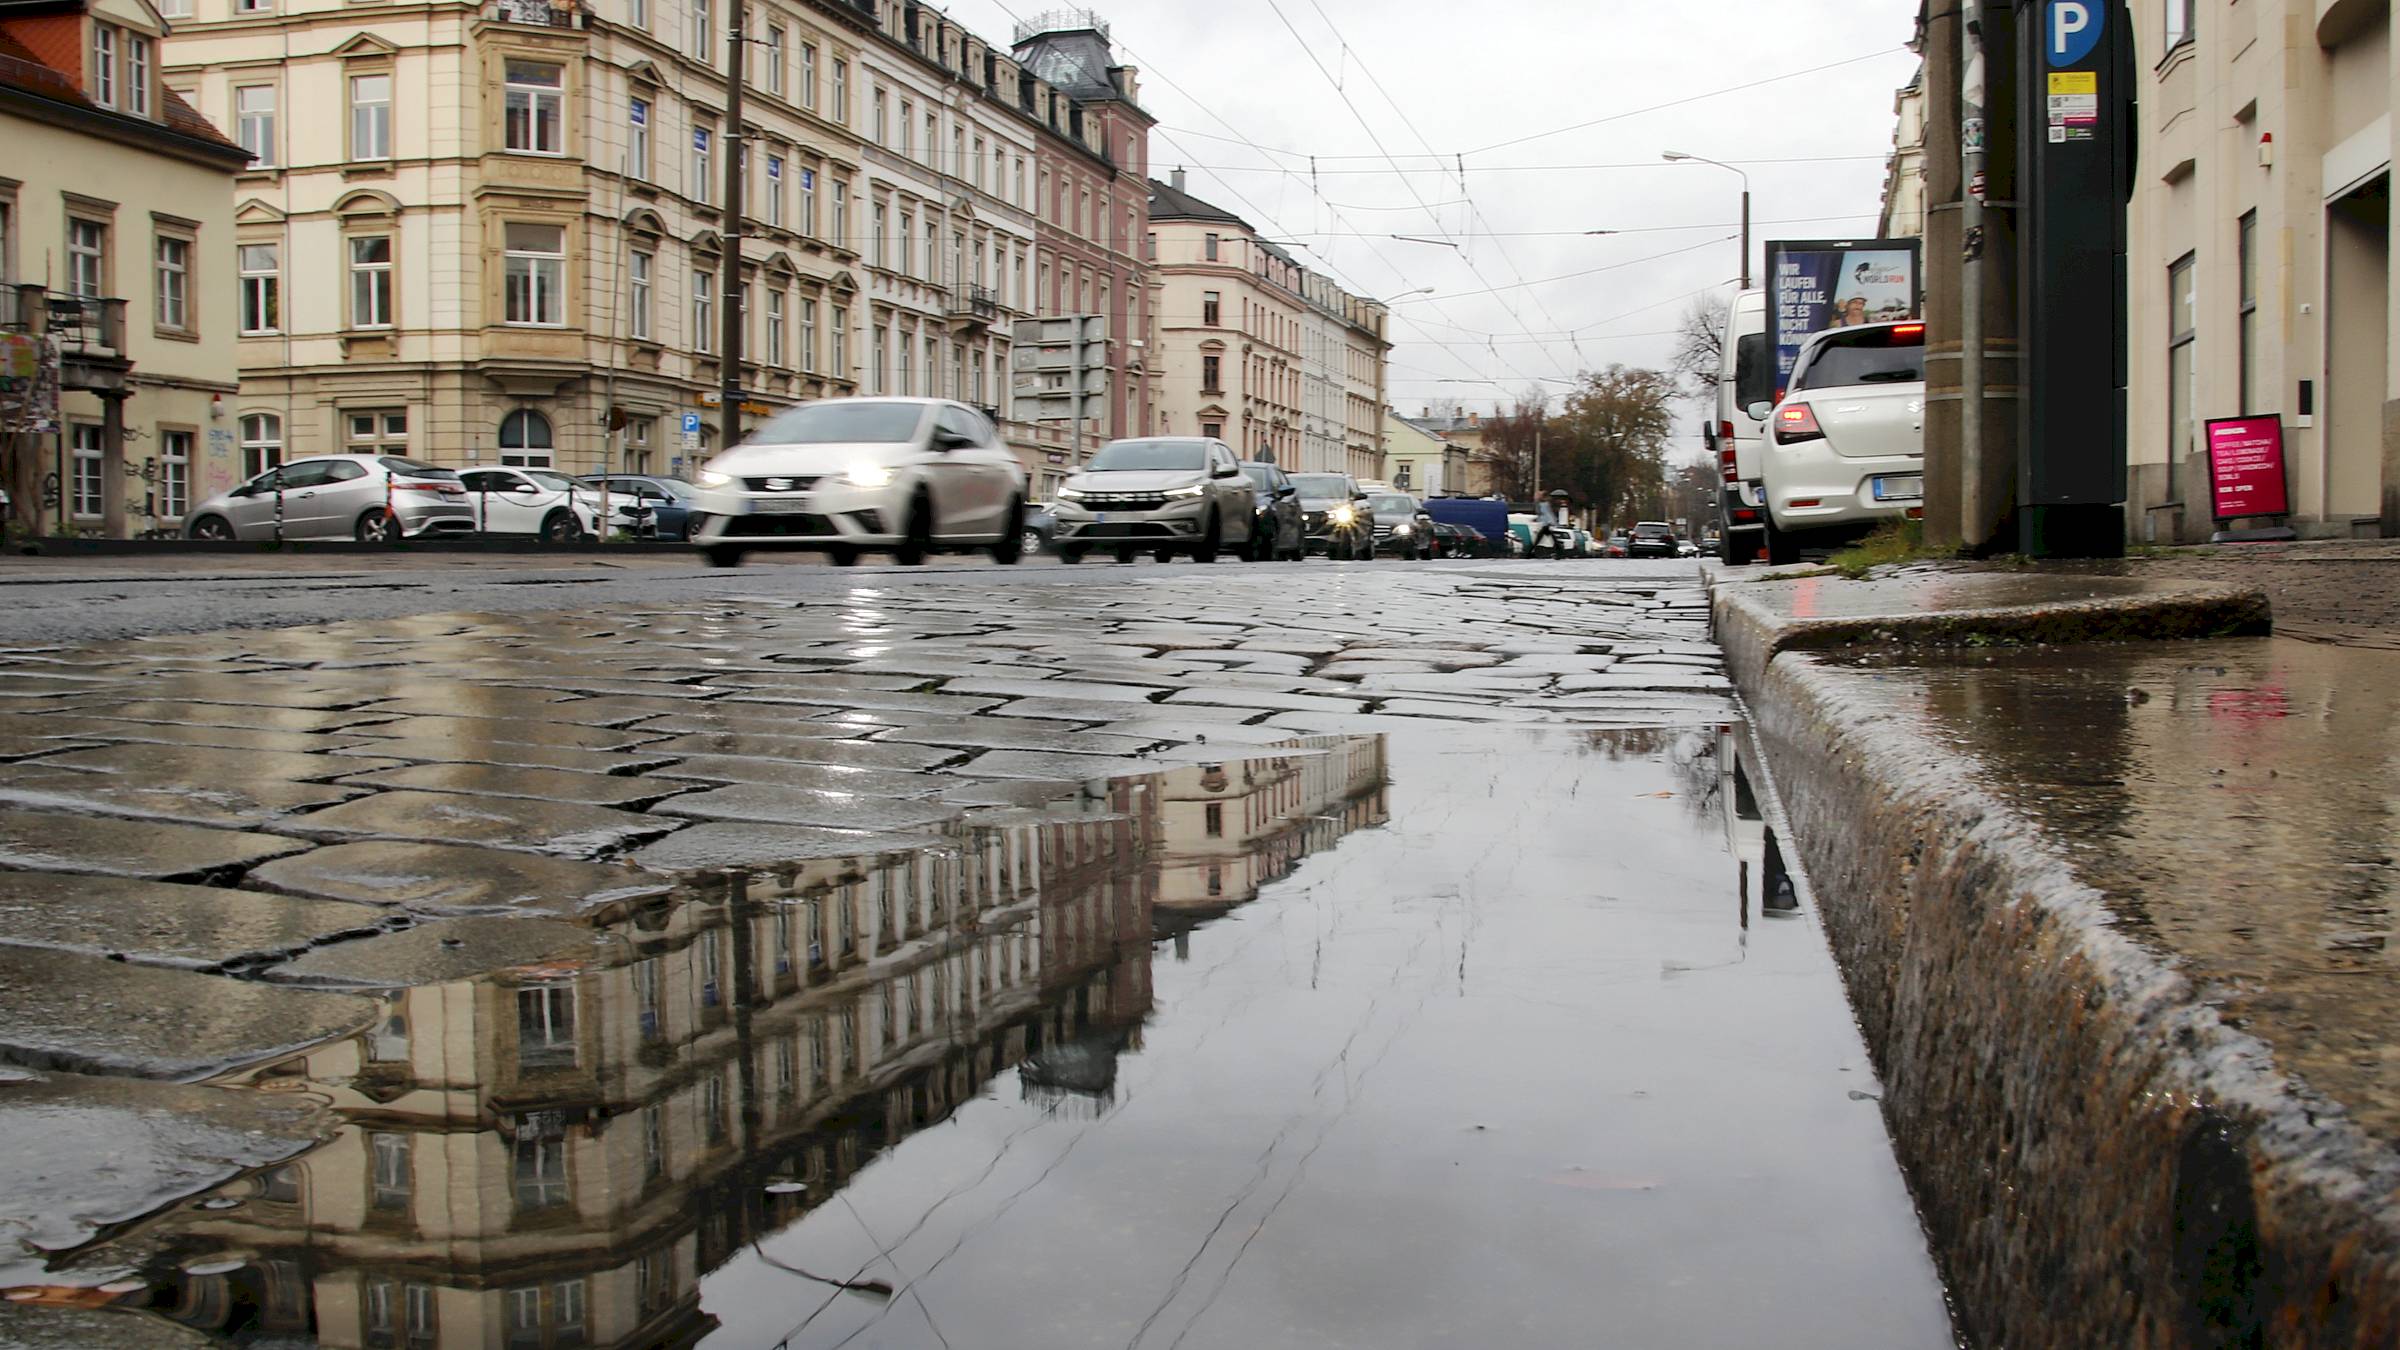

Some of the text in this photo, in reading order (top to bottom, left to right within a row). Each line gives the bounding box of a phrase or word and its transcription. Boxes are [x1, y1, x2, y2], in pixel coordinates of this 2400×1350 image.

[2054, 2, 2088, 53] P
[1779, 264, 1800, 275] WIR
[1779, 277, 1816, 289] LAUFEN
[1779, 289, 1827, 305] FÜR ALLE,
[1779, 305, 1811, 318] DIE ES
[1779, 319, 1809, 331] NICHT
[685, 417, 696, 430] P
